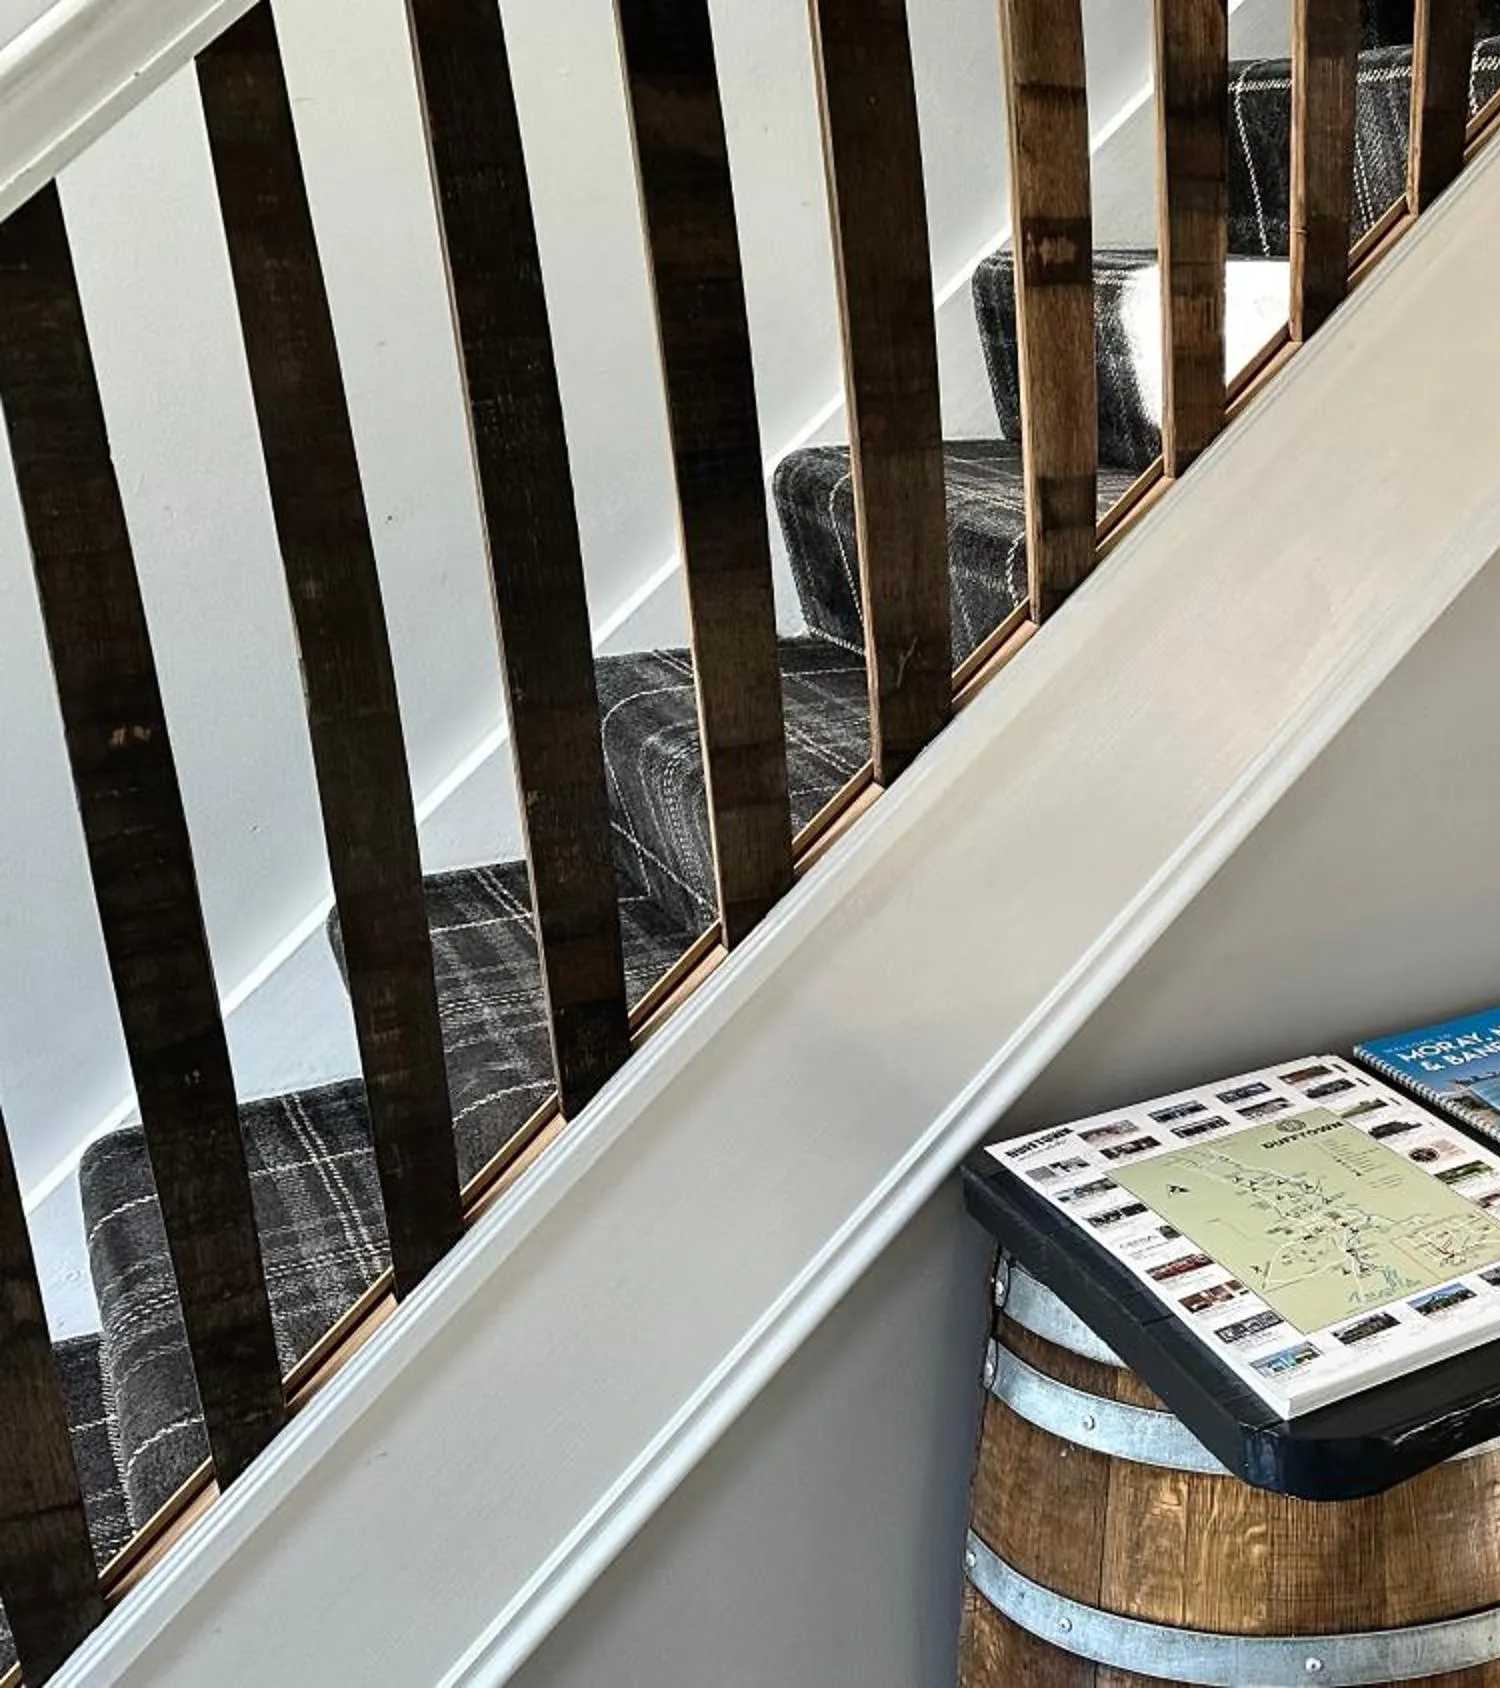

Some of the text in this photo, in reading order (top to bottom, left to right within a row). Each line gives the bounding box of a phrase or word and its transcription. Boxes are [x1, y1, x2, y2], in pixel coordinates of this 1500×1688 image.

[1398, 1031, 1493, 1063] MORAY,
[1420, 1059, 1446, 1073] &
[1261, 1121, 1345, 1149] DUFFTOWN
